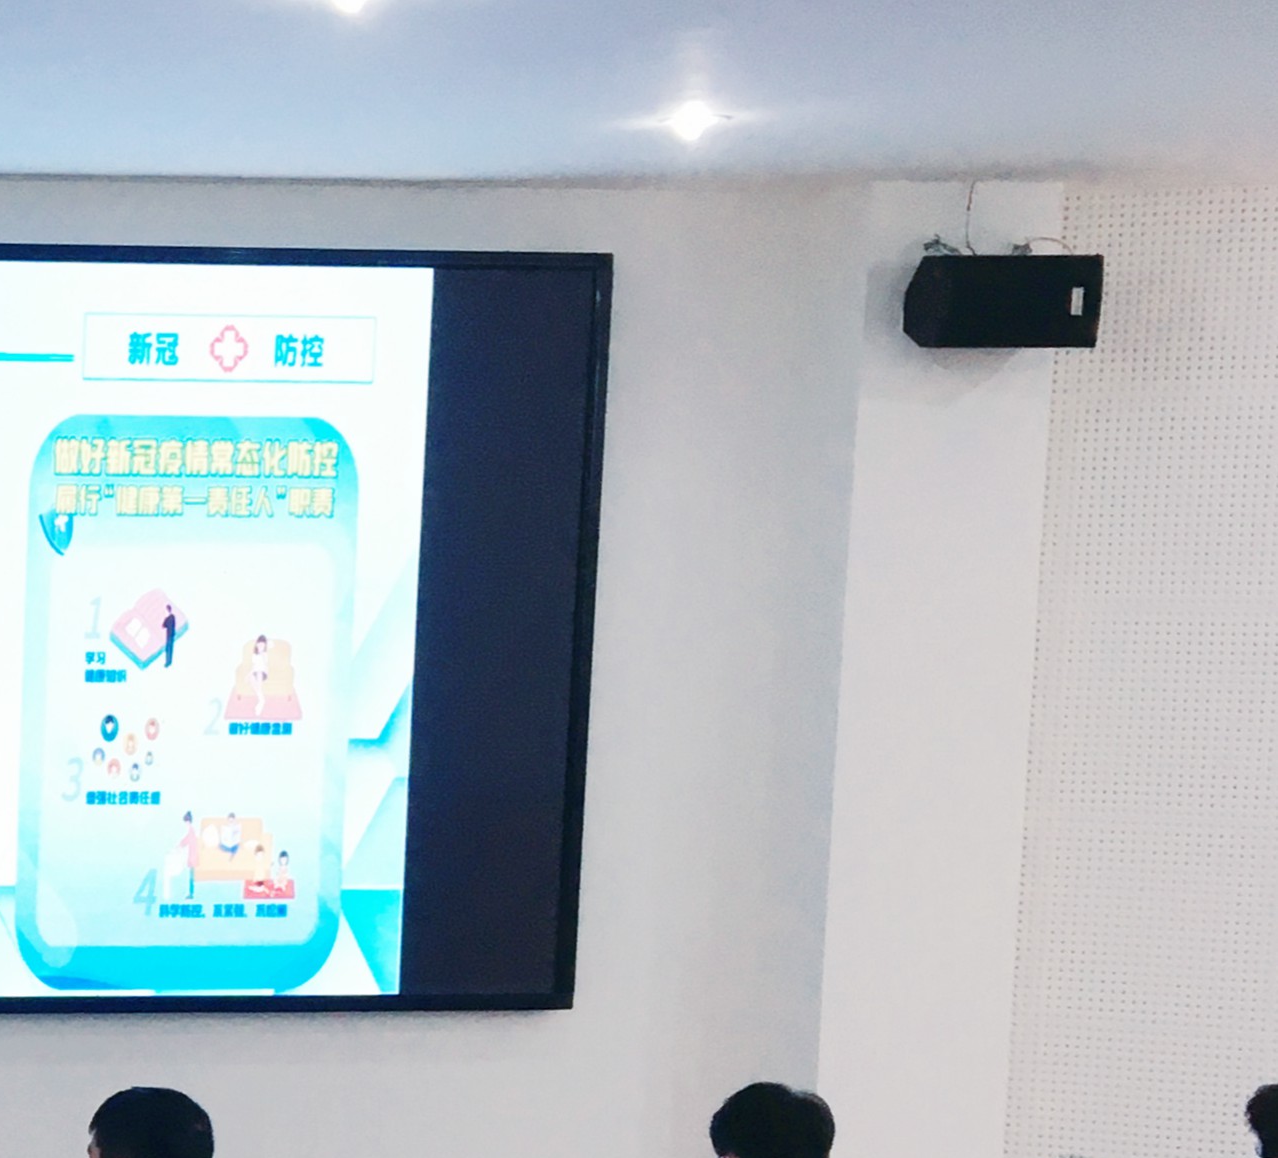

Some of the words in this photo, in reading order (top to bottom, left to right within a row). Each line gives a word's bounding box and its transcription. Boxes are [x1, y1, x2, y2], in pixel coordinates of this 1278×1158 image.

[127, 331, 179, 366] 新冠
[273, 333, 325, 368] 防控
[54, 436, 338, 478] 做好新冠疫情常态化防控
